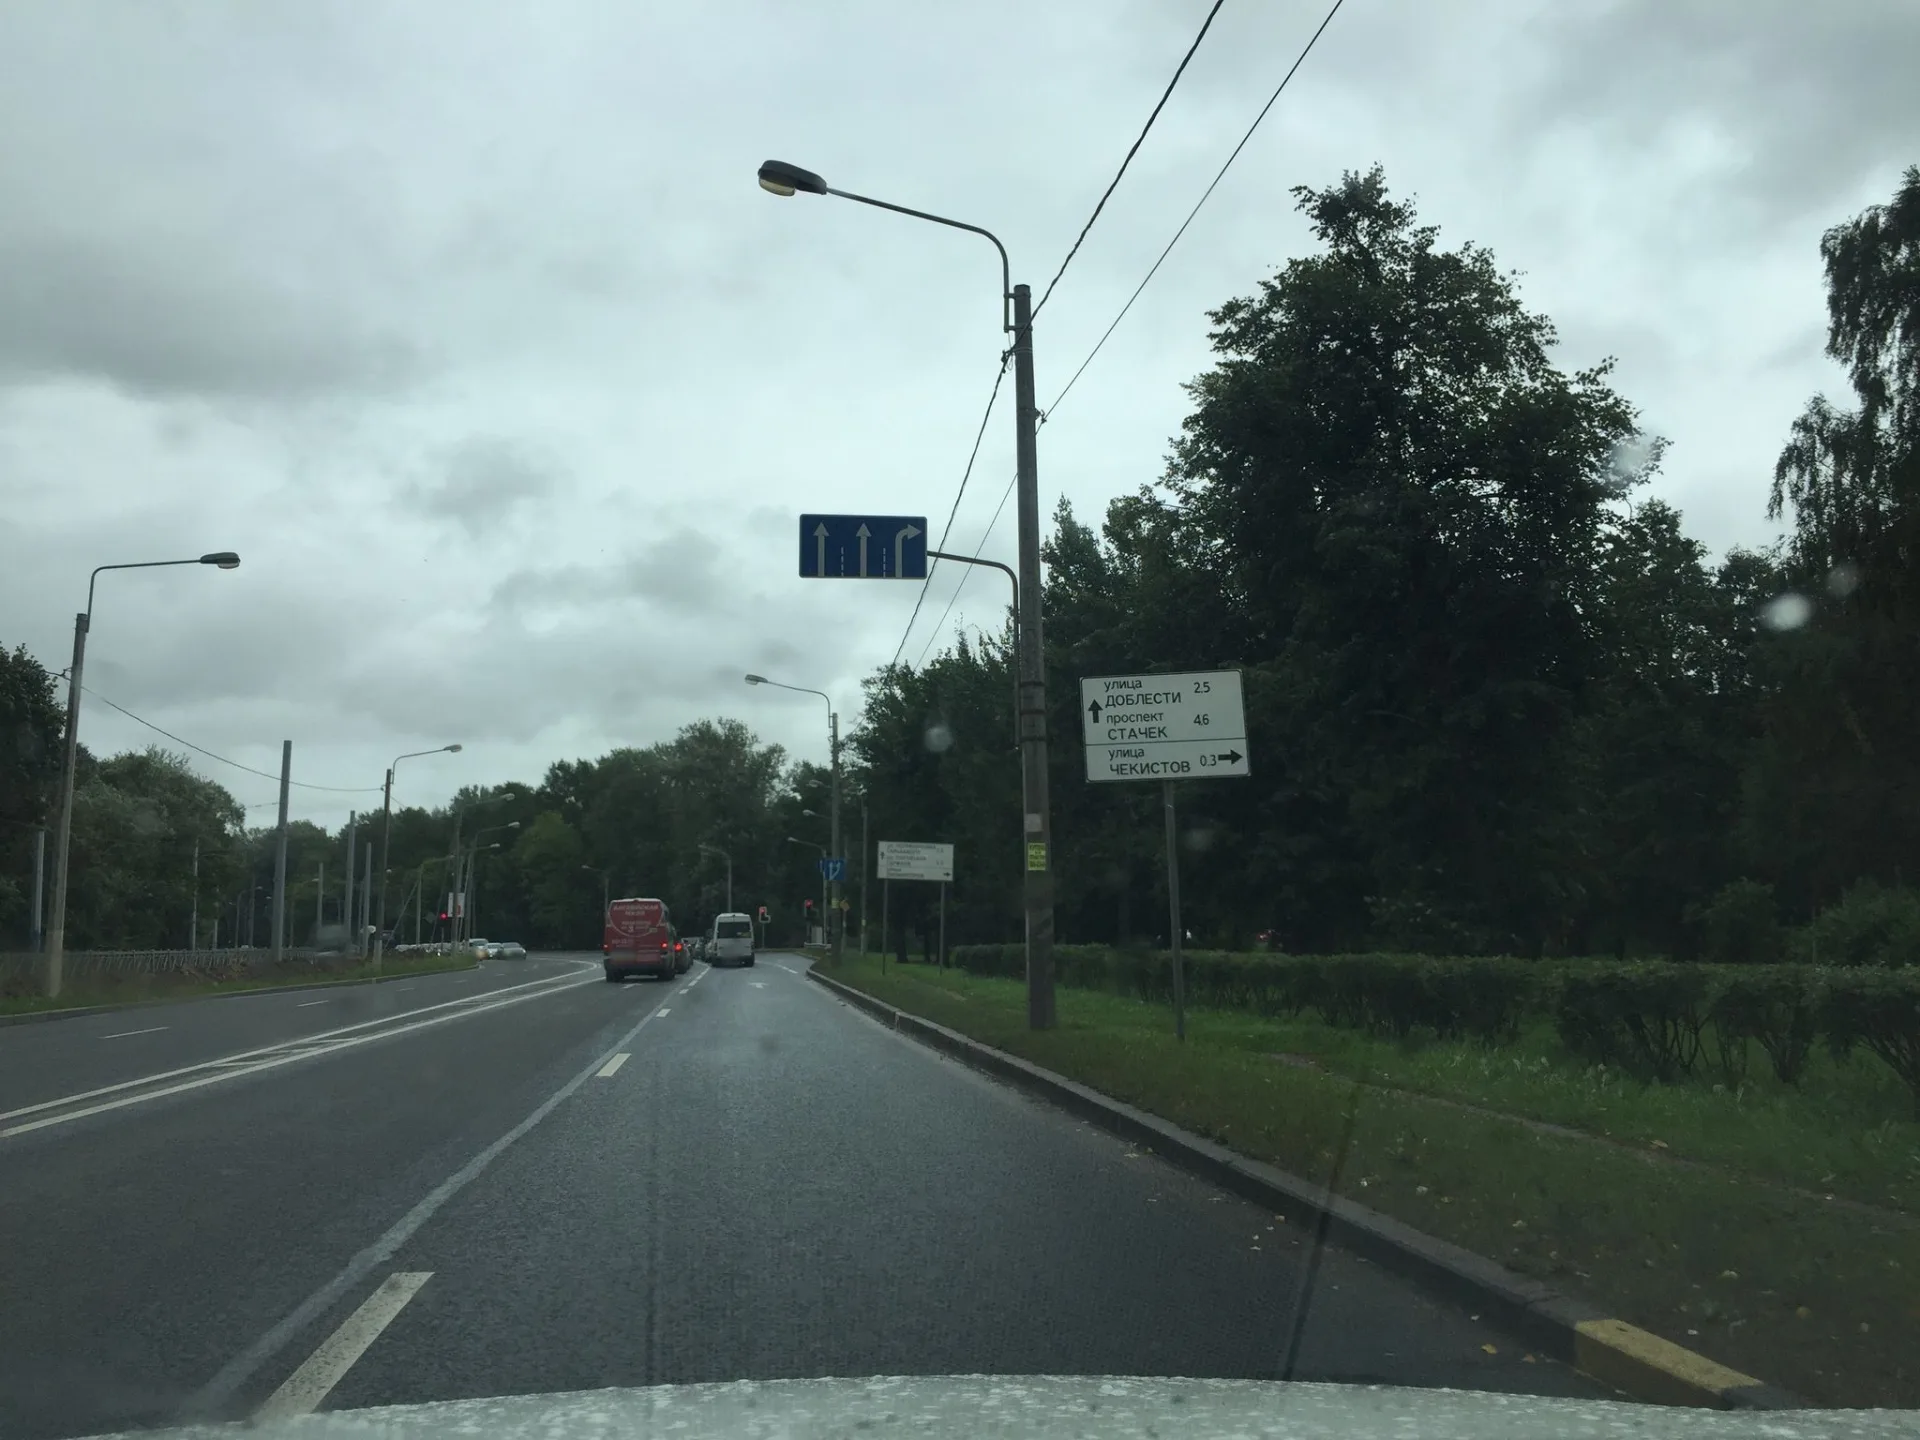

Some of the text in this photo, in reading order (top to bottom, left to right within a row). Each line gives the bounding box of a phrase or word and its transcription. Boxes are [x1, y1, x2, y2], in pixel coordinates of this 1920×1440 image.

[1104, 679, 1142, 692] улица
[1193, 681, 1211, 693] 2.5
[1105, 692, 1182, 708] ДОБЛЕСТИ
[1106, 712, 1164, 726] проспект
[1193, 713, 1210, 726] 4.6
[1107, 726, 1168, 740] СТАЧЕК
[1108, 748, 1145, 760] улица
[1199, 754, 1217, 767] 0.3
[1110, 761, 1191, 775] ЧЕКИСТОВ
